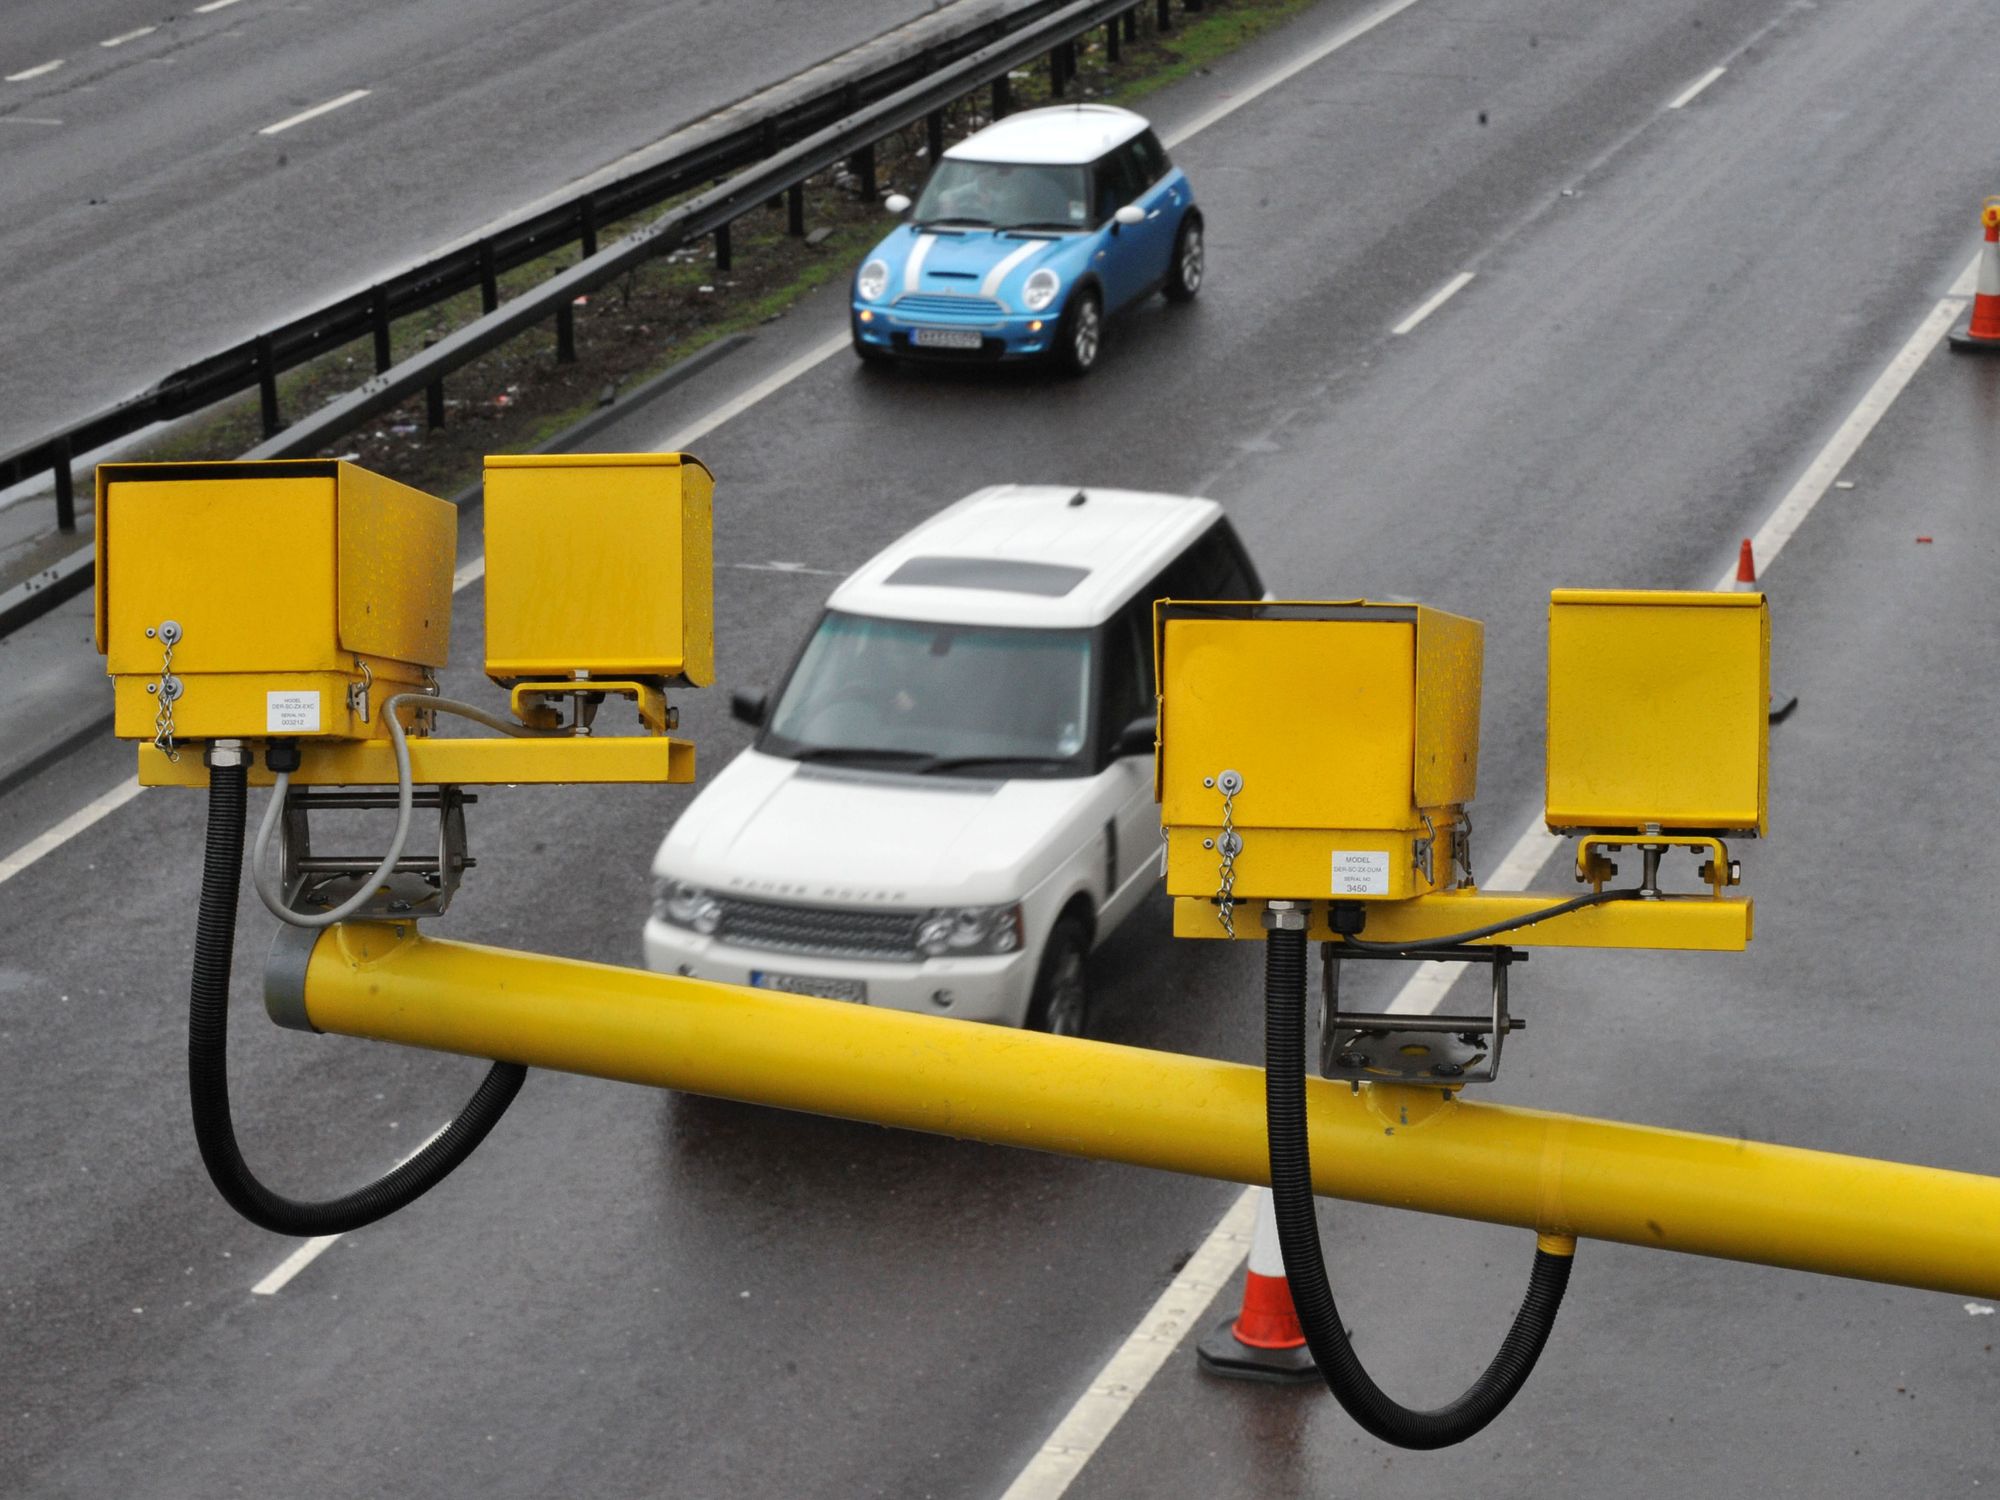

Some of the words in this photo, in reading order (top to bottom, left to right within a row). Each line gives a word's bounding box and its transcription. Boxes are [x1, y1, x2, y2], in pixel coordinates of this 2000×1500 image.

[730, 877, 807, 894] RANGE
[822, 887, 906, 901] ROVER
[1346, 884, 1367, 892] 3450
